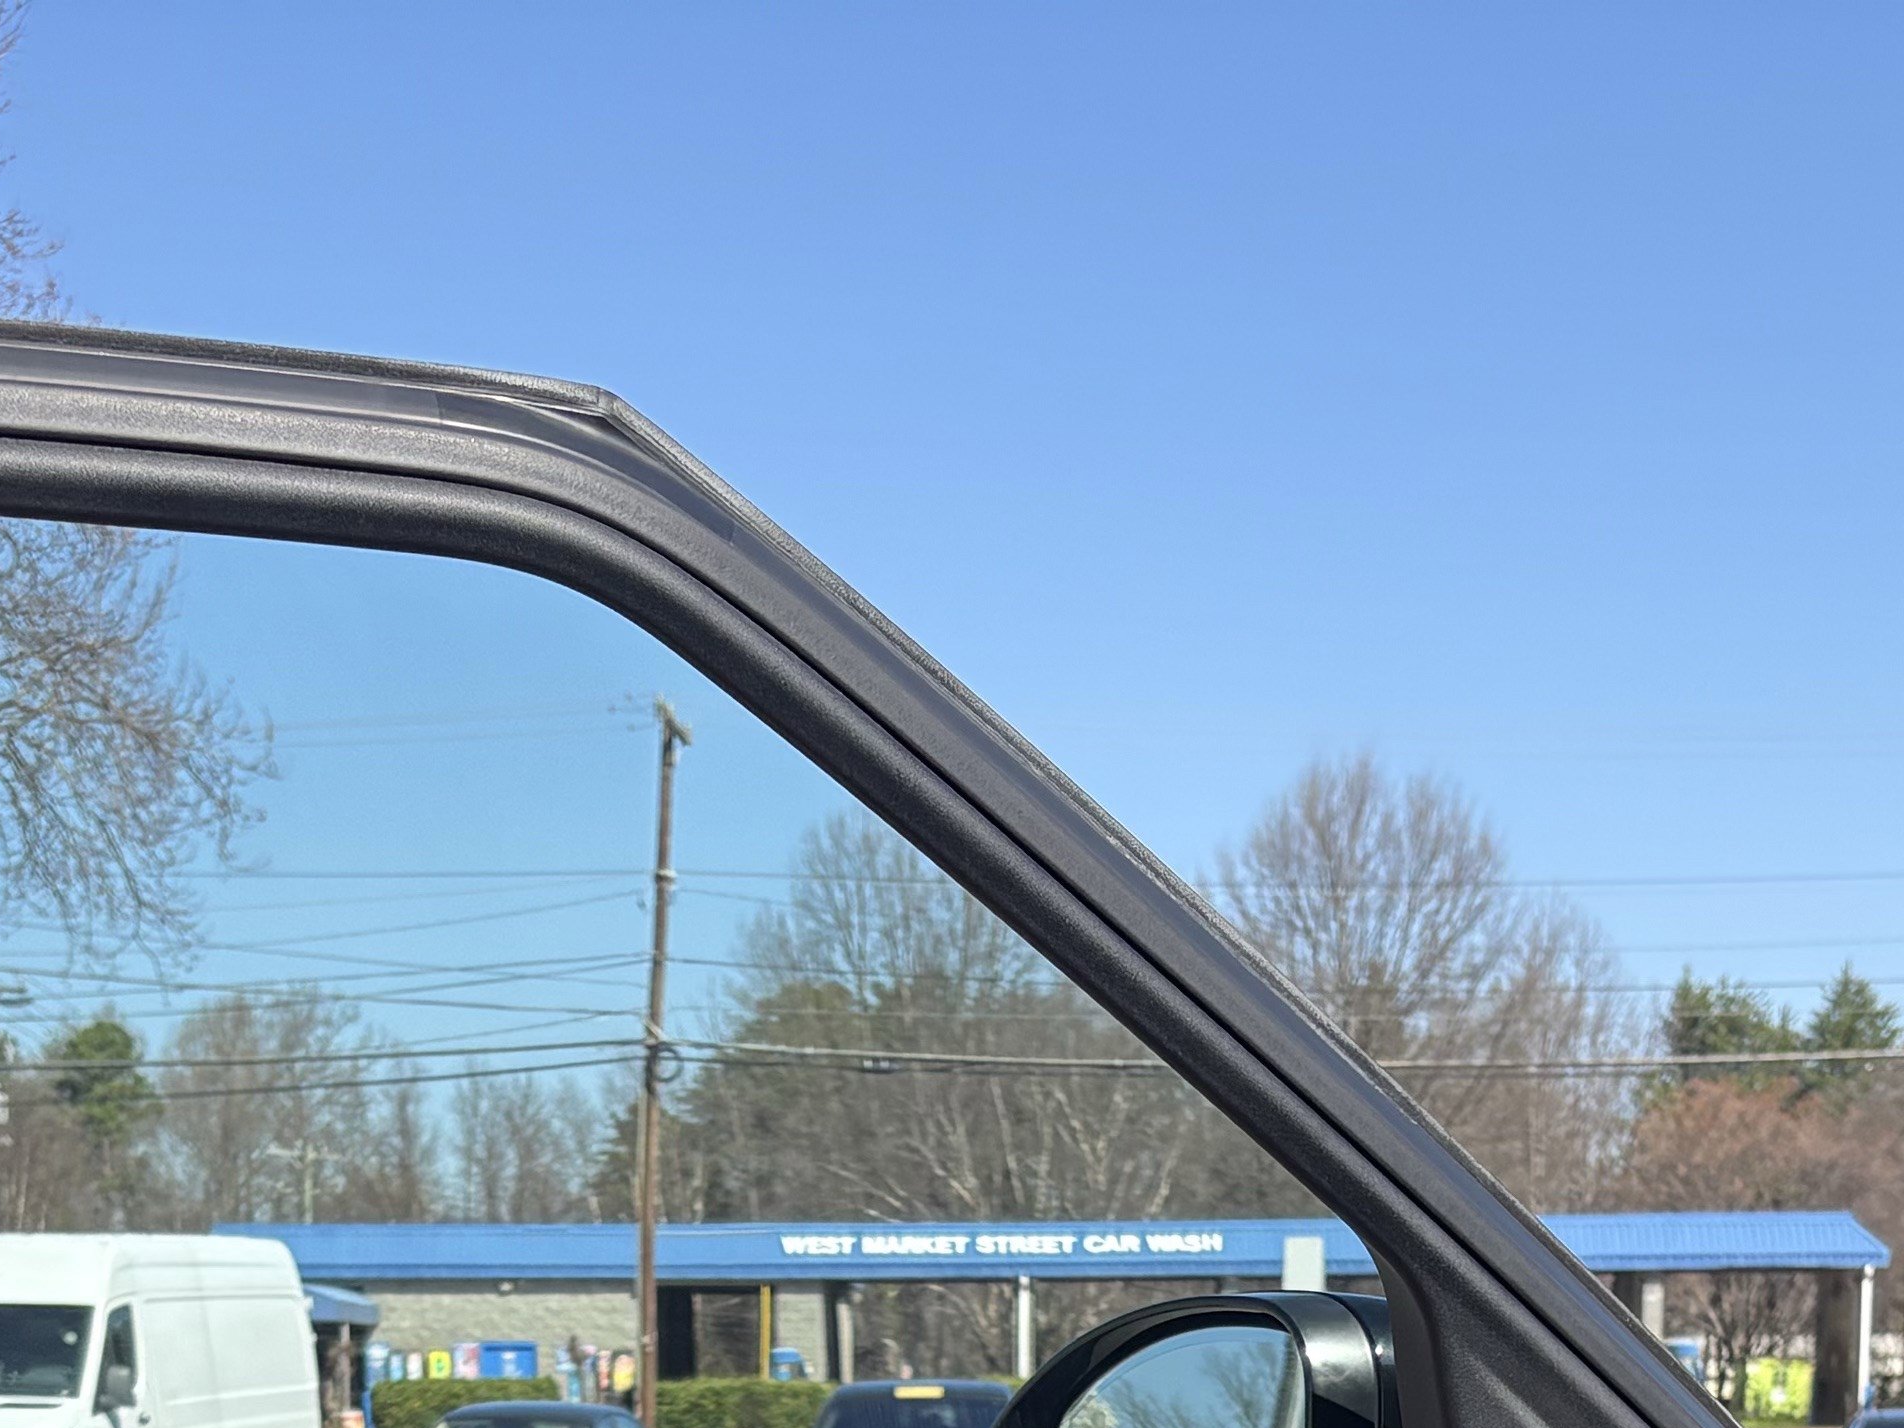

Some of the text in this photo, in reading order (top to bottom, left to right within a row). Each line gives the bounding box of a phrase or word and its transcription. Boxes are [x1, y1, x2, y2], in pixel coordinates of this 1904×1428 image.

[780, 1233, 1224, 1255] WEST MARKET STREET CAR WASH
